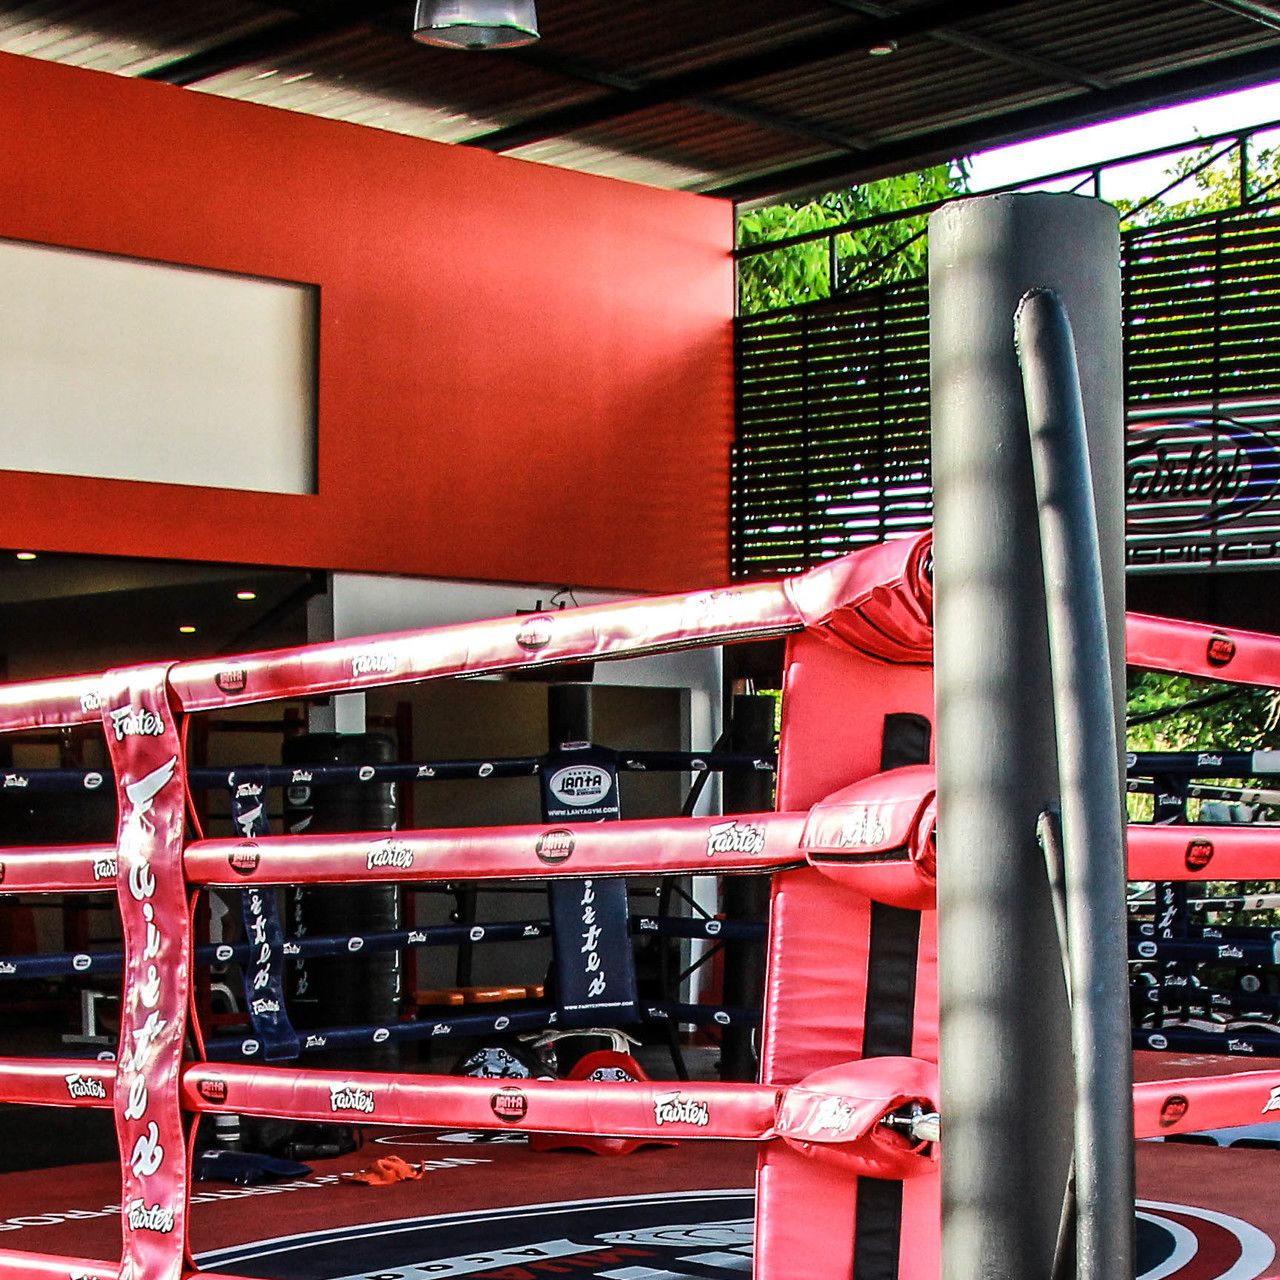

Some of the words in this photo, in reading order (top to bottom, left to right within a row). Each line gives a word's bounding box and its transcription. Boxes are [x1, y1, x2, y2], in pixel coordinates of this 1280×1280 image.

[706, 820, 766, 858] Fairtex
[65, 1073, 107, 1099] Fairtex
[330, 1084, 375, 1113] Fairtex
[653, 1090, 710, 1128] Fairtex
[127, 1198, 175, 1234] Fairtex
